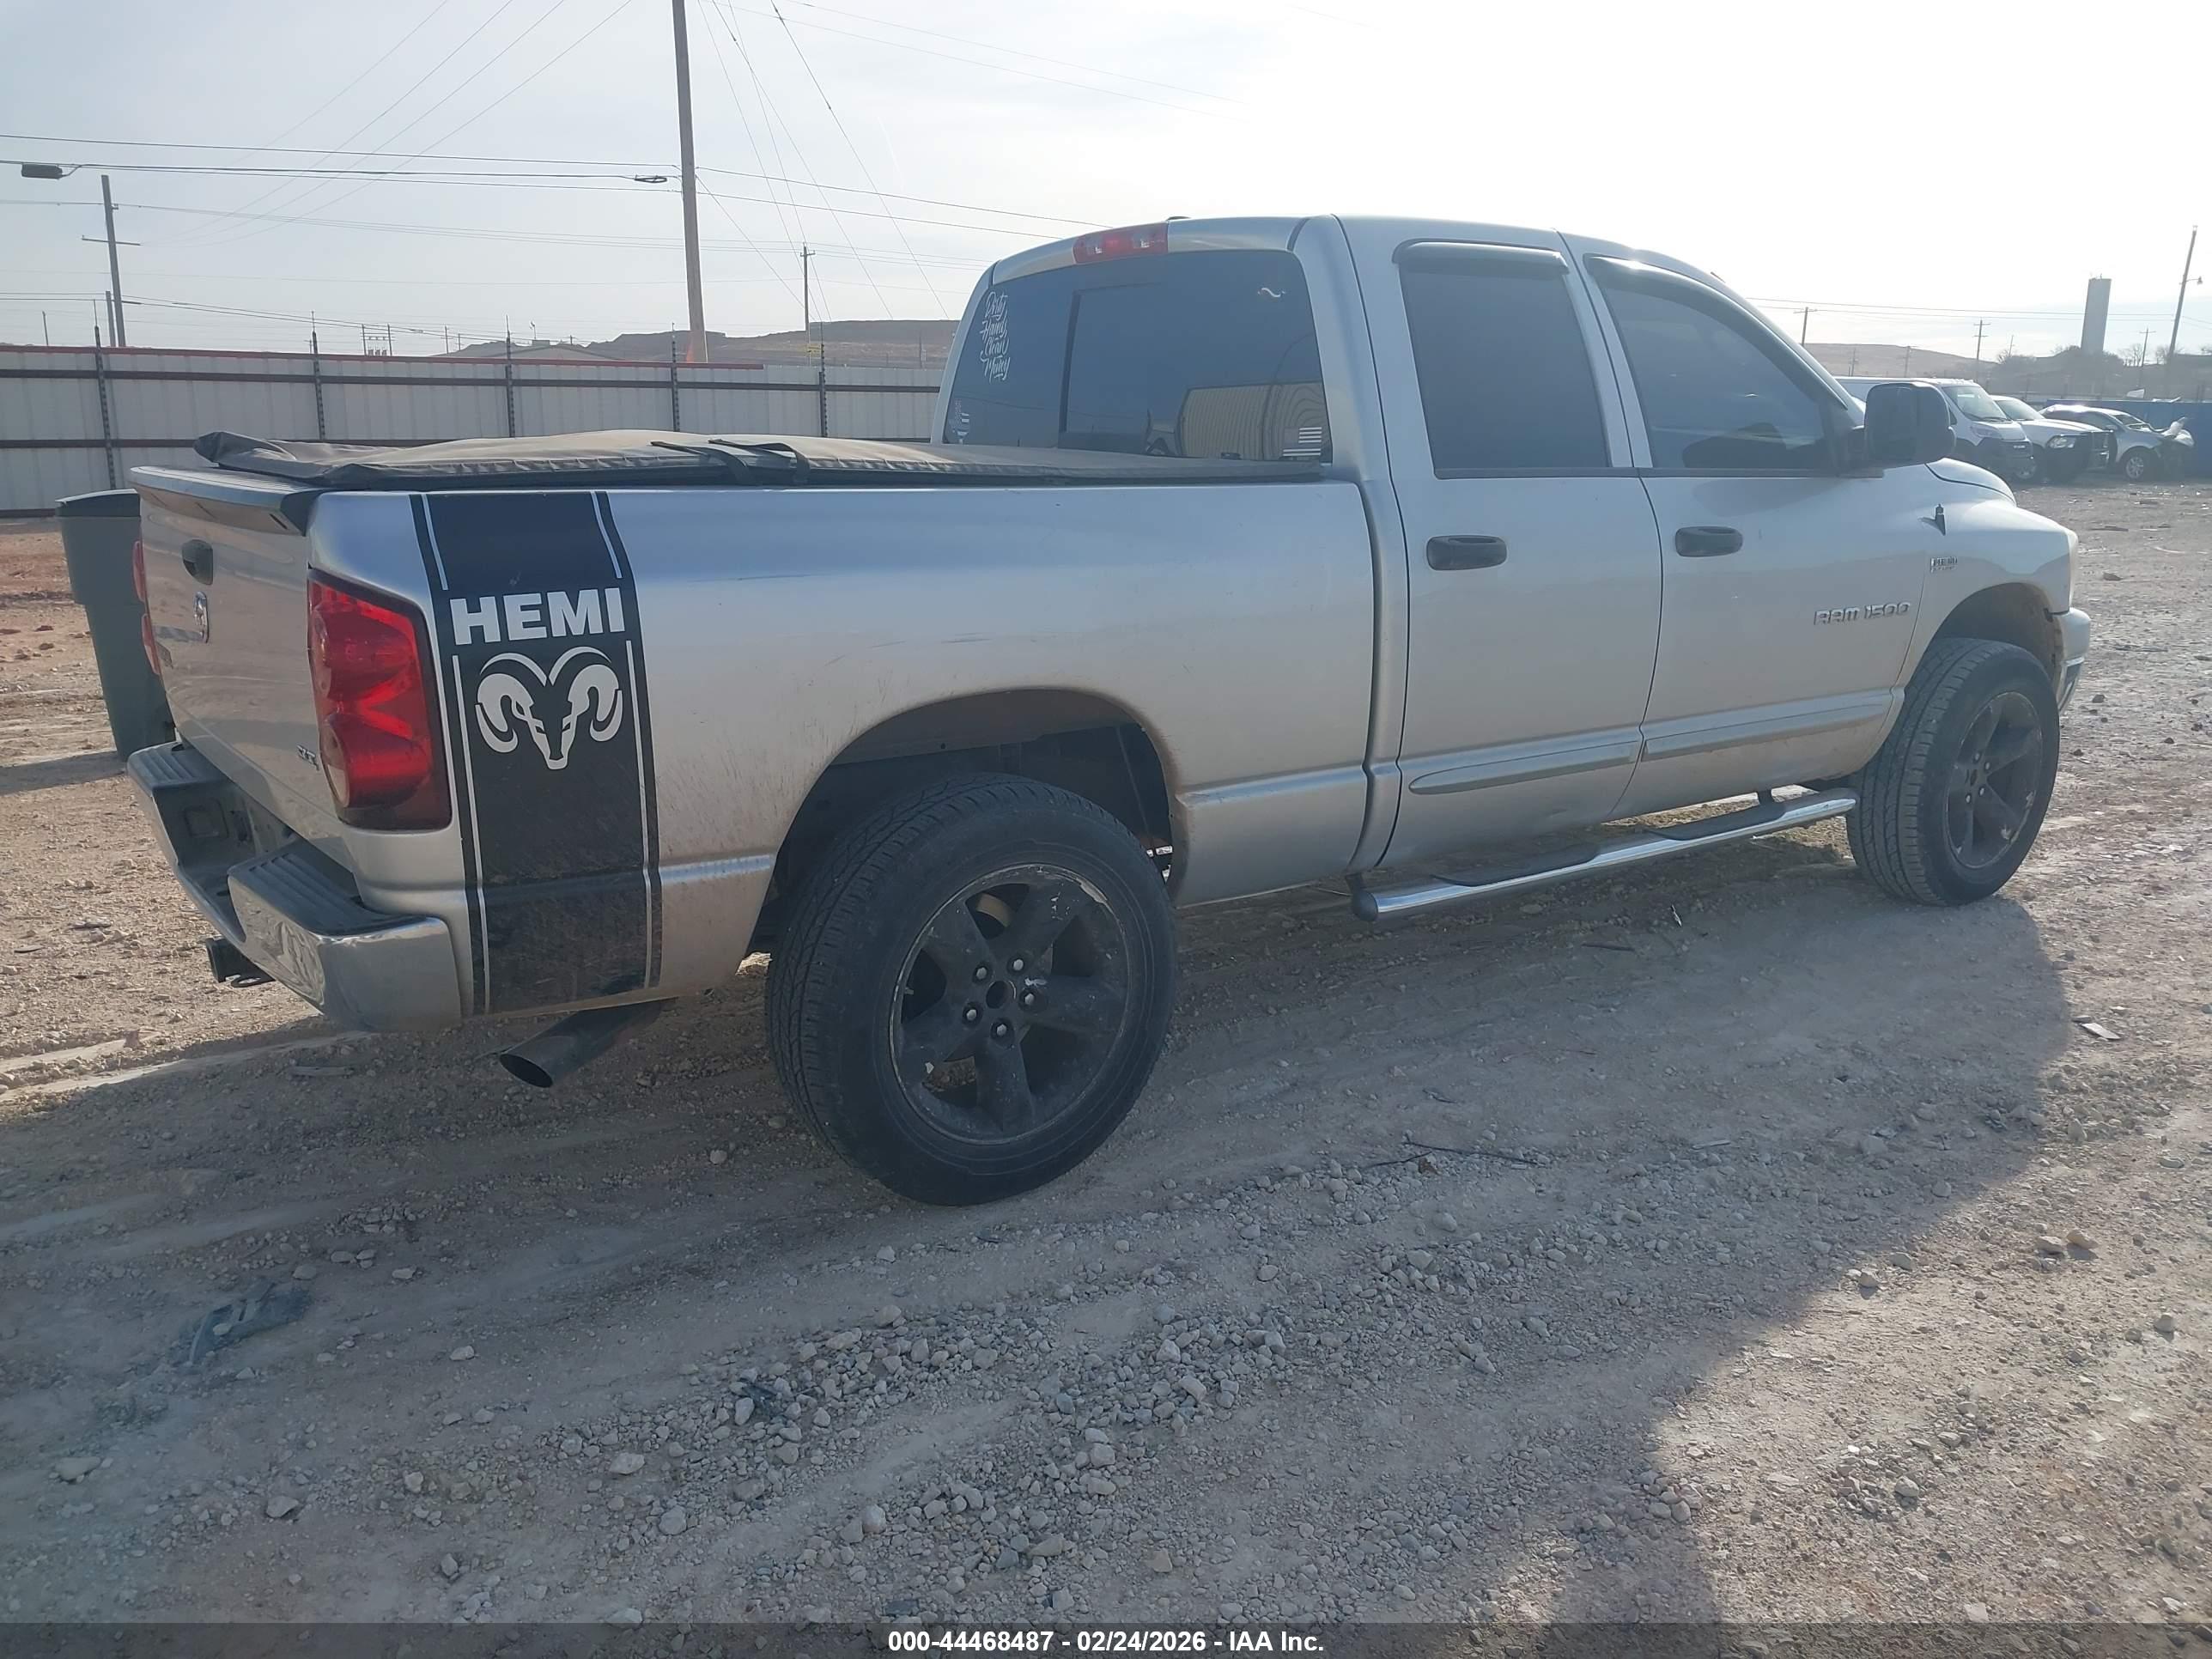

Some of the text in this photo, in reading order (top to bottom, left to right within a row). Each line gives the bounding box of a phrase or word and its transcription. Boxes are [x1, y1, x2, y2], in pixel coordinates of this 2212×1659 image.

[449, 587, 625, 645] HEMI
[1814, 601, 1911, 625] RAM 1500
